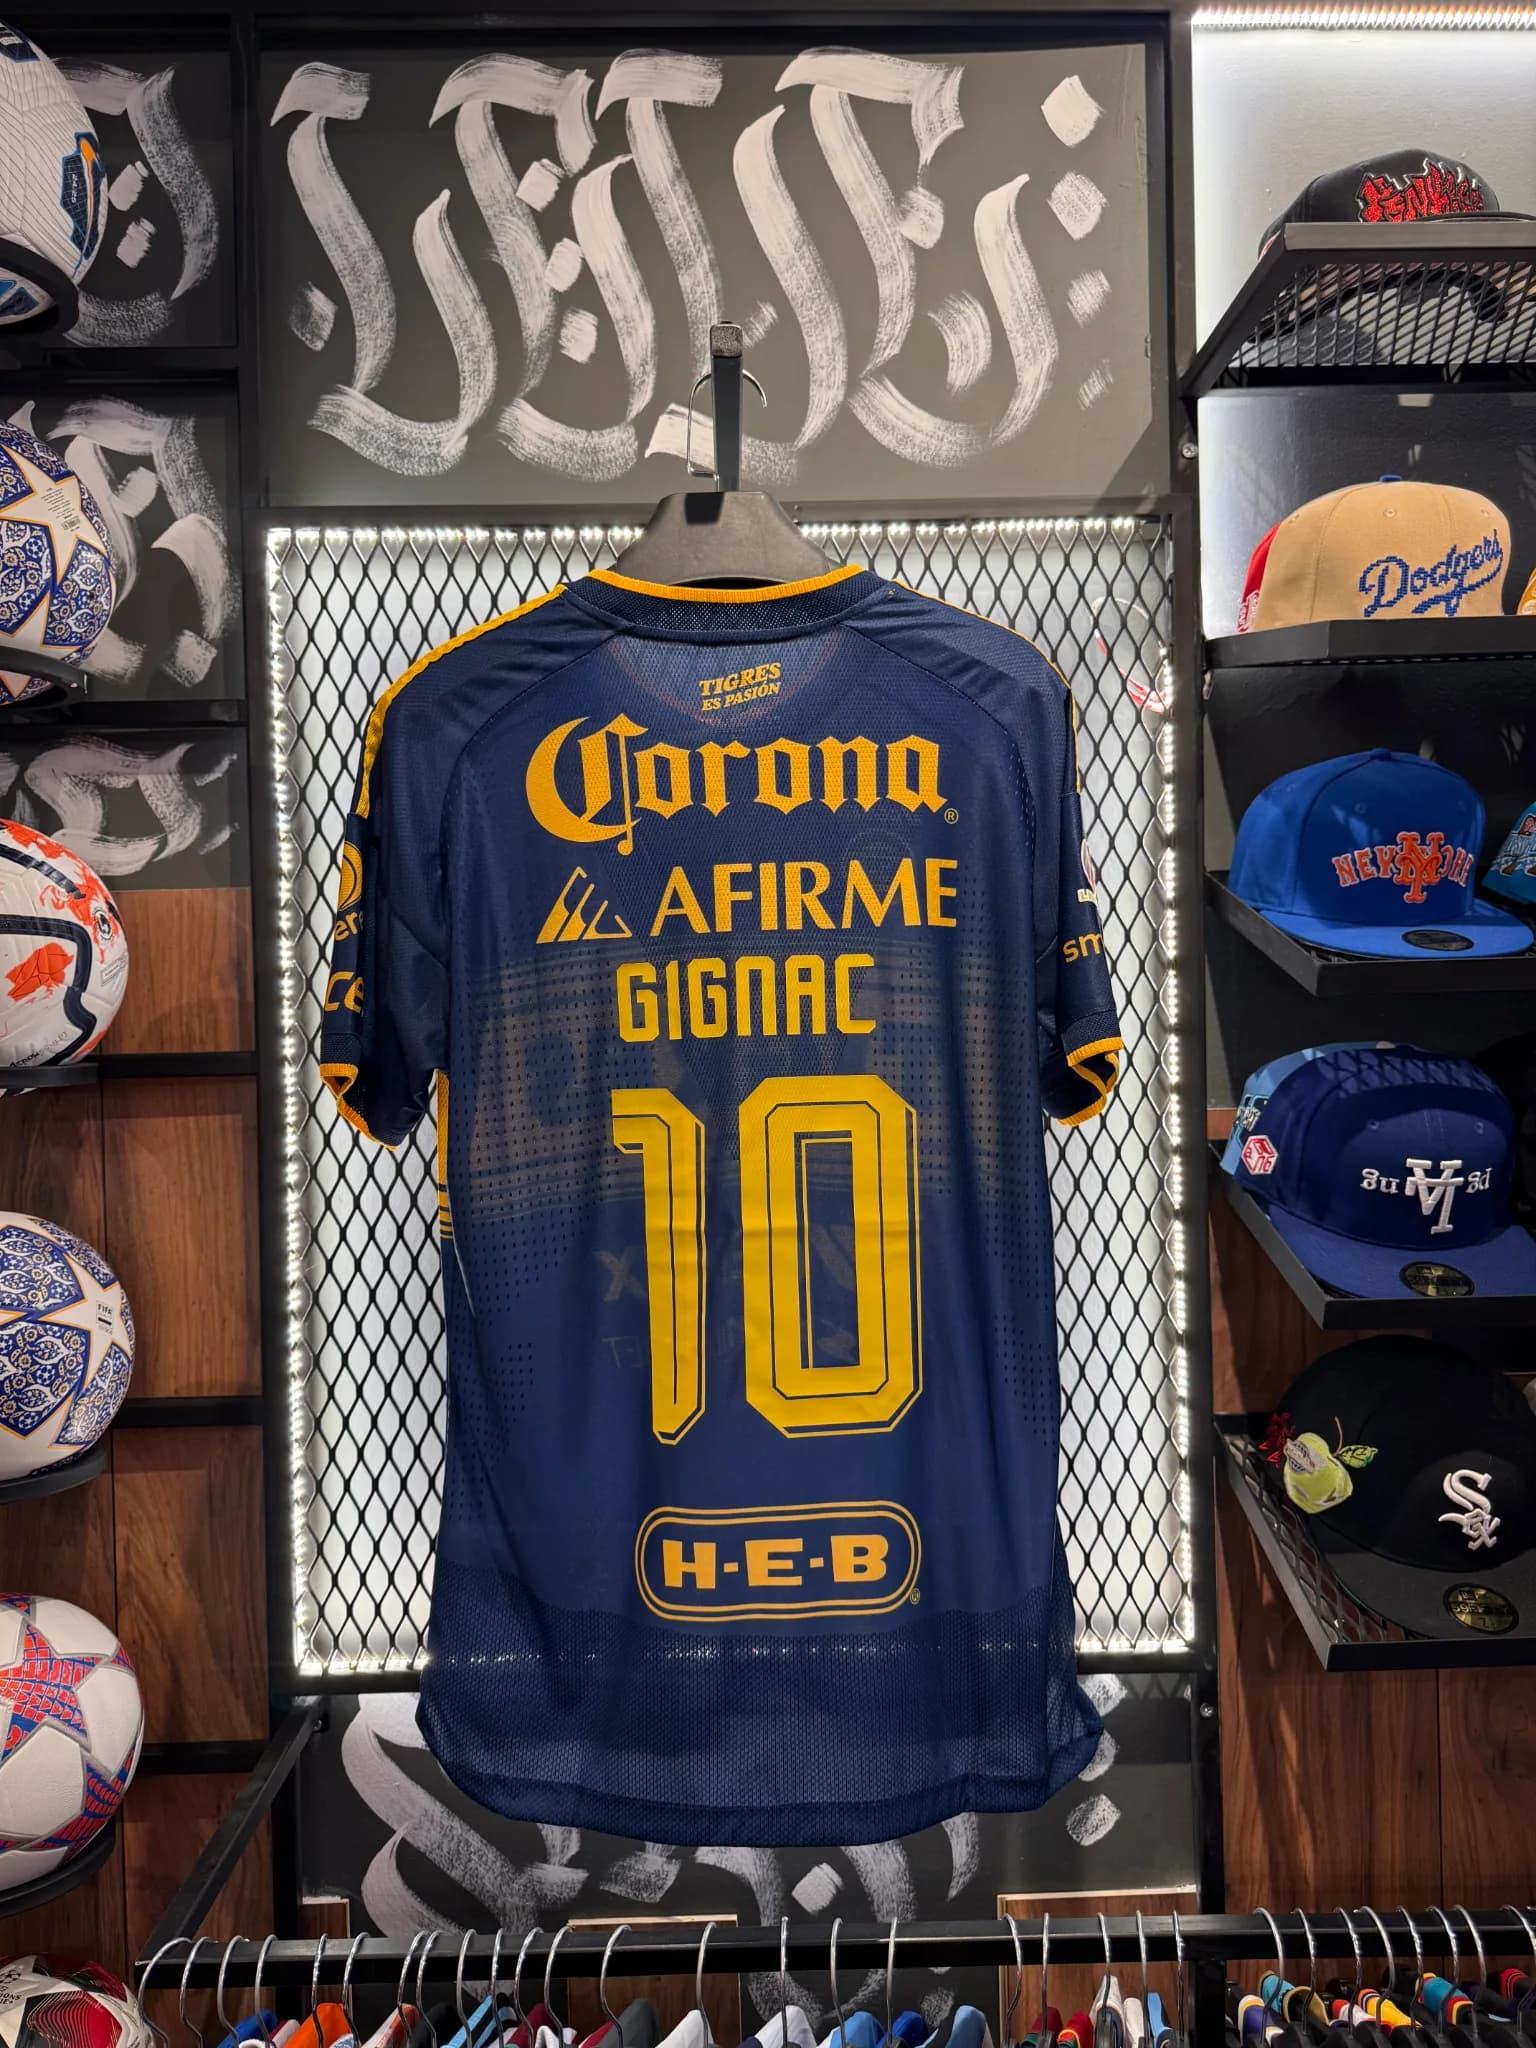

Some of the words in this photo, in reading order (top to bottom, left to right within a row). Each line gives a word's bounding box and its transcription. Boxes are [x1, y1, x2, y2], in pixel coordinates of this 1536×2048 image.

[1359, 528, 1503, 618] Dodgers
[699, 662, 781, 696] TIGRES
[702, 698, 721, 711] ES
[724, 681, 781, 708] PASIÓN
[526, 713, 948, 856] Corona
[650, 857, 958, 937] AFIRME
[616, 953, 877, 1042] GIGNAC
[611, 1075, 923, 1445] 10
[662, 1533, 889, 1590] H-E-B
